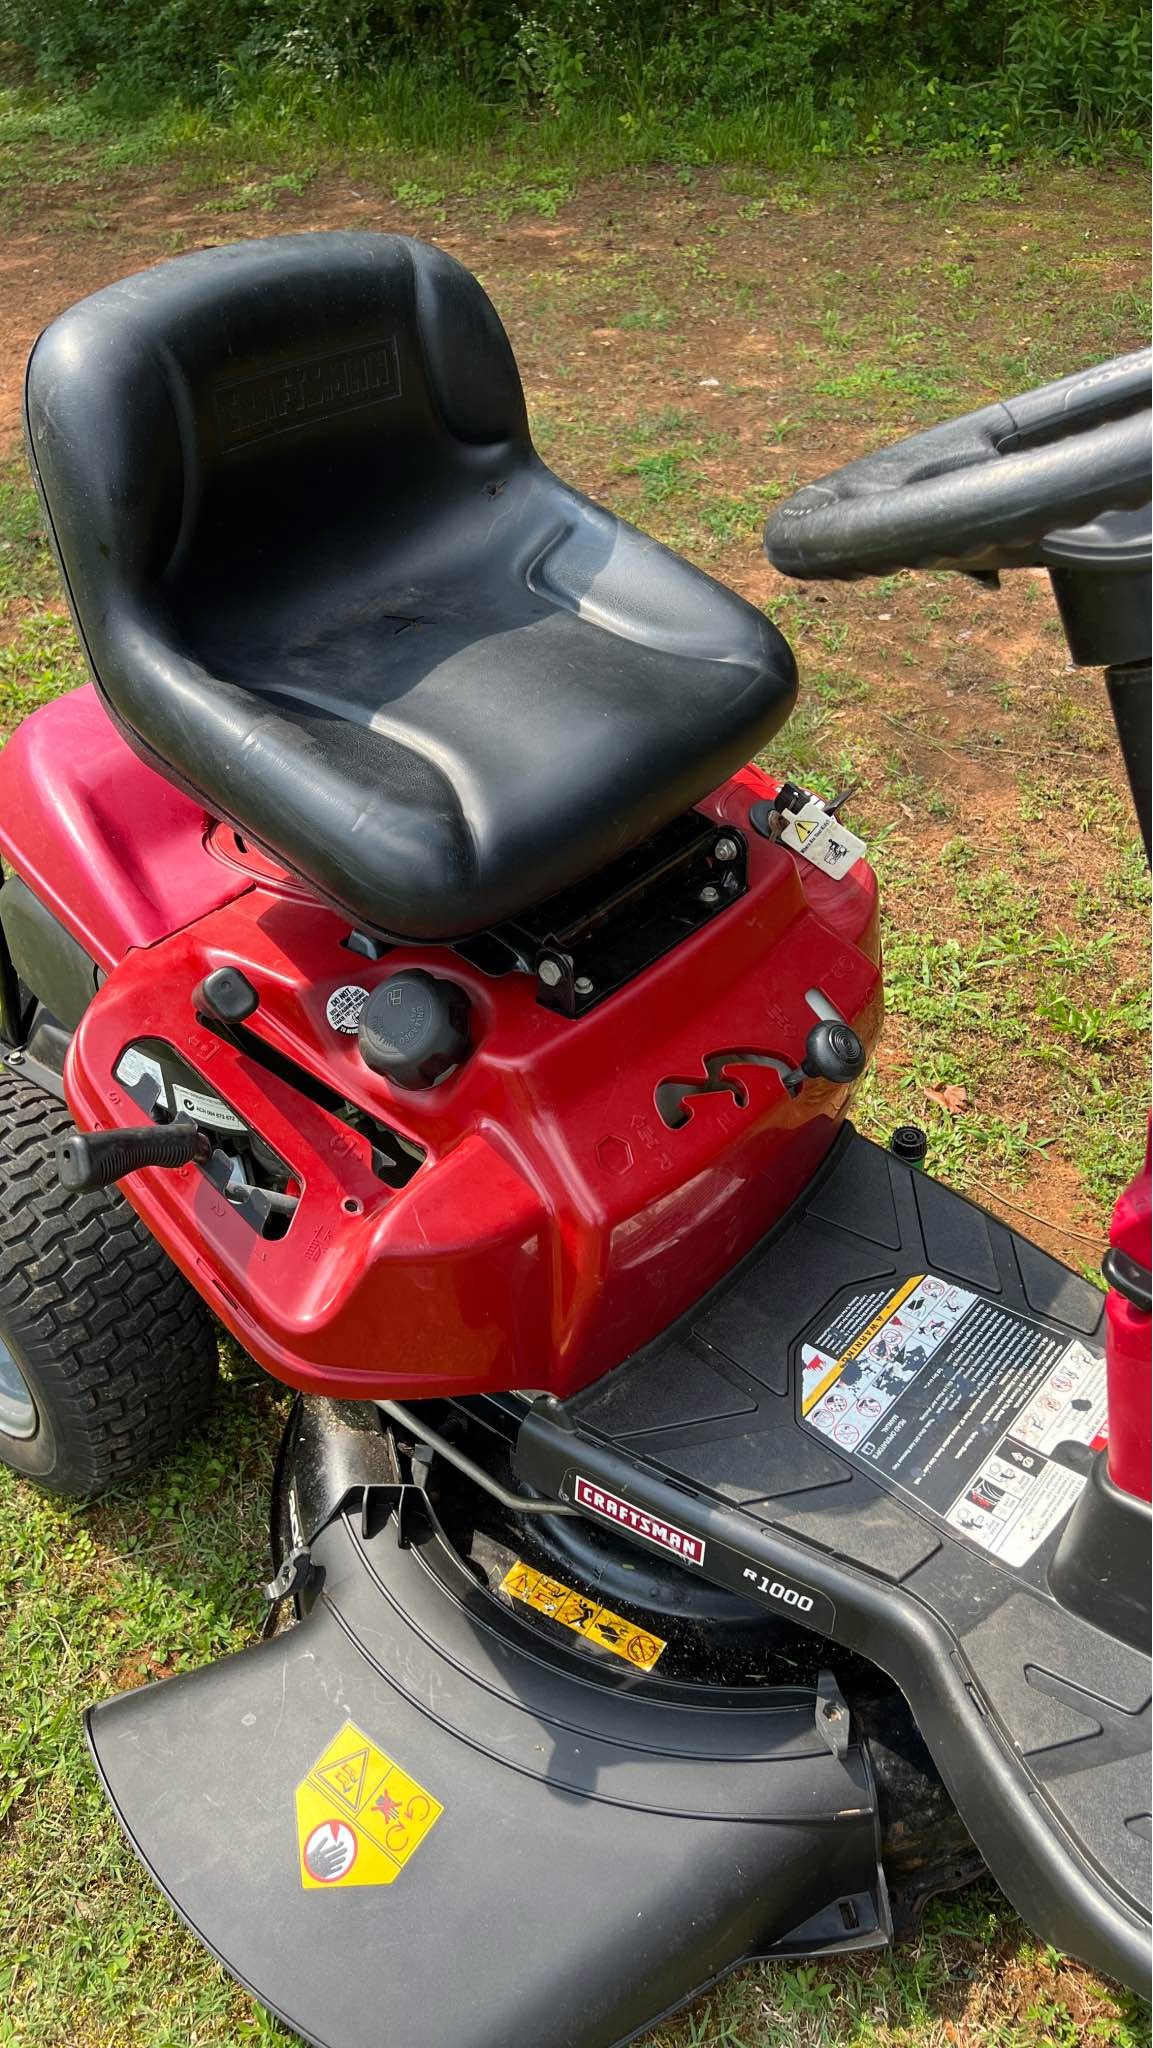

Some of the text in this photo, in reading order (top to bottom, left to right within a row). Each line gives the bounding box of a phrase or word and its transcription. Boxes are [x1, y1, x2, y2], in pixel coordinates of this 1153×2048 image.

[331, 988, 351, 1007] DO NOT
[350, 988, 361, 998] FUEL
[331, 992, 365, 1021] CONTAINING MORE
[333, 1015, 345, 1026] THAN
[841, 1323, 879, 1363] WARNING
[881, 1414, 899, 1433] MANUAL
[583, 1487, 696, 1556] CRAFTSMAN
[743, 1567, 814, 1612] R1000
